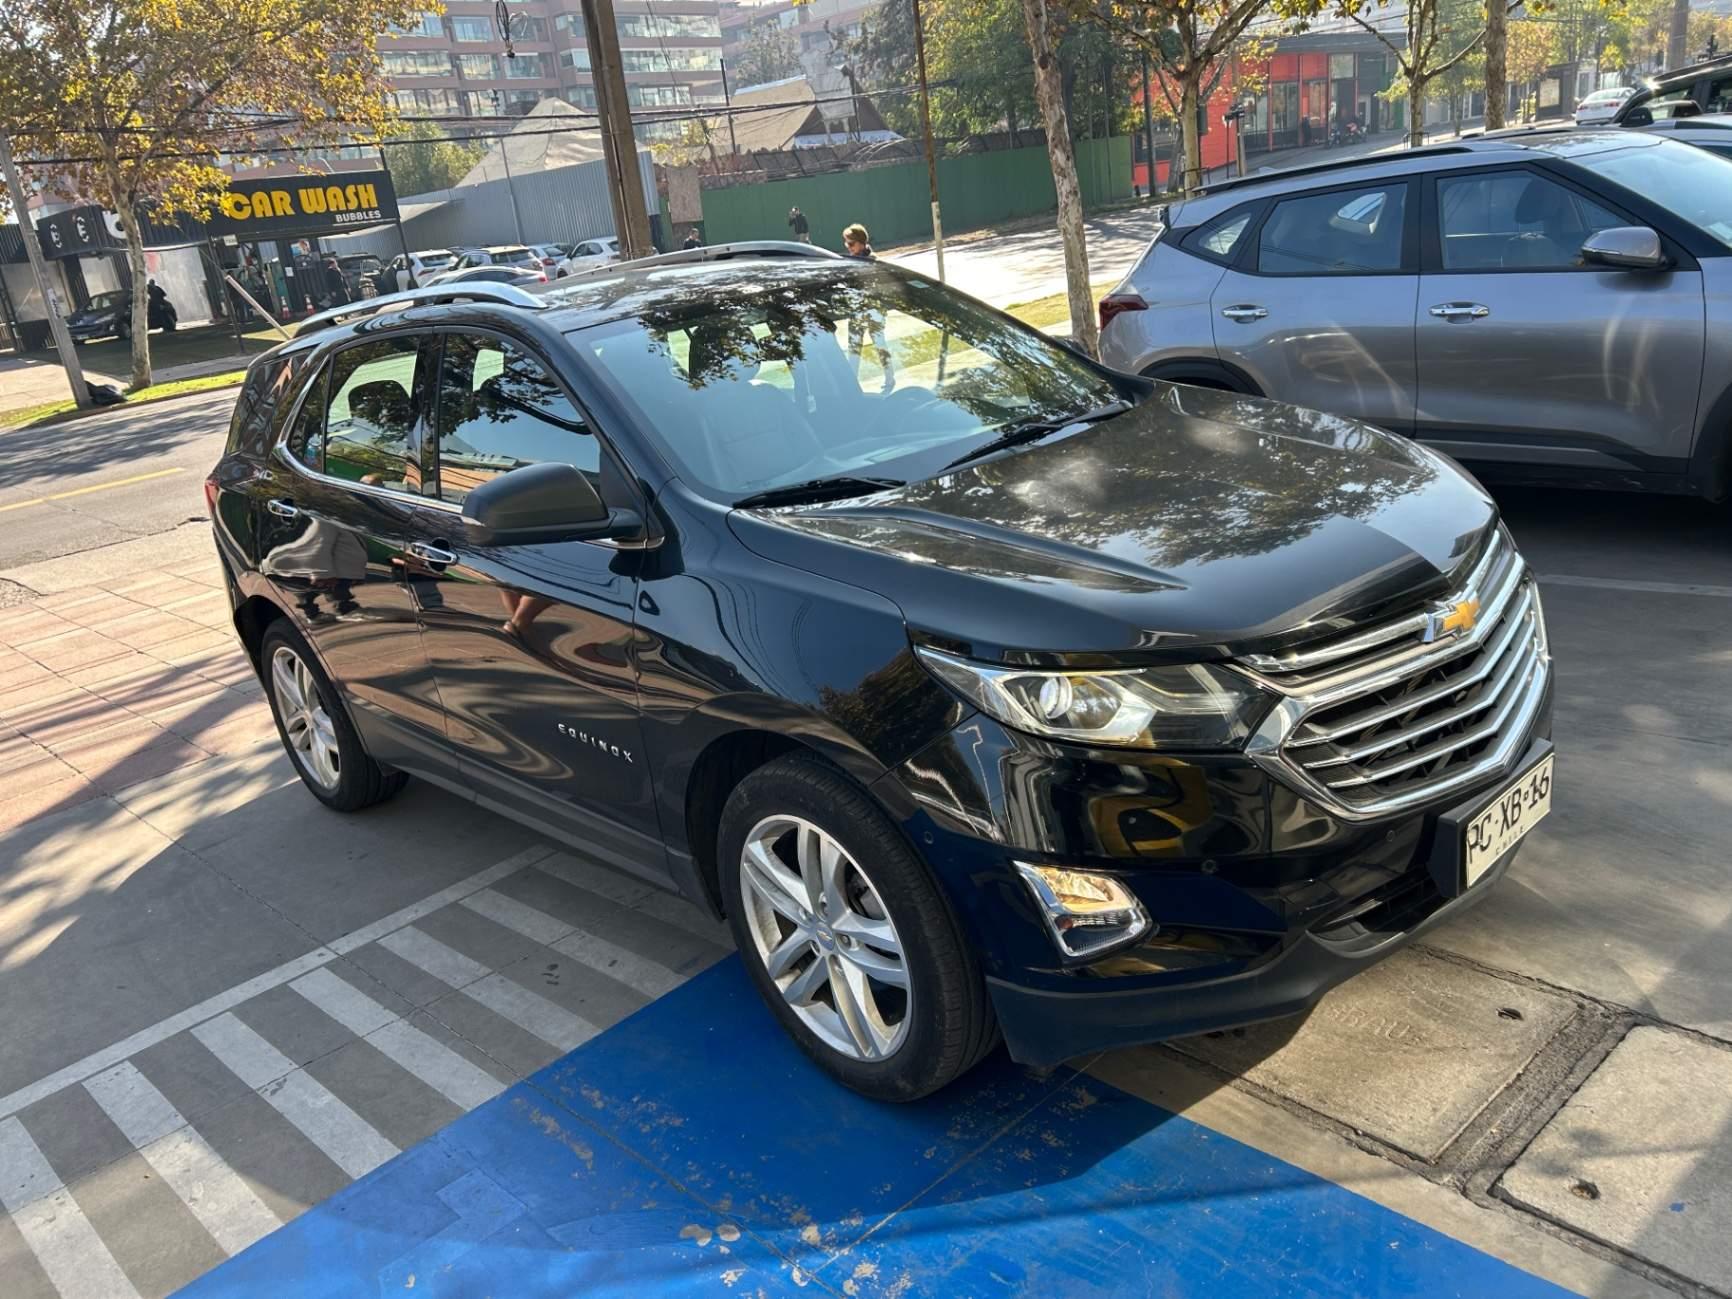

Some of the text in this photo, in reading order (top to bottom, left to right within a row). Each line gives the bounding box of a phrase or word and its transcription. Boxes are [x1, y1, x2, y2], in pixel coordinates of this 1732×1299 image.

[228, 183, 378, 220] CAR WASH
[335, 210, 382, 222] BUBBLES
[557, 722, 633, 763] EQUINOX
